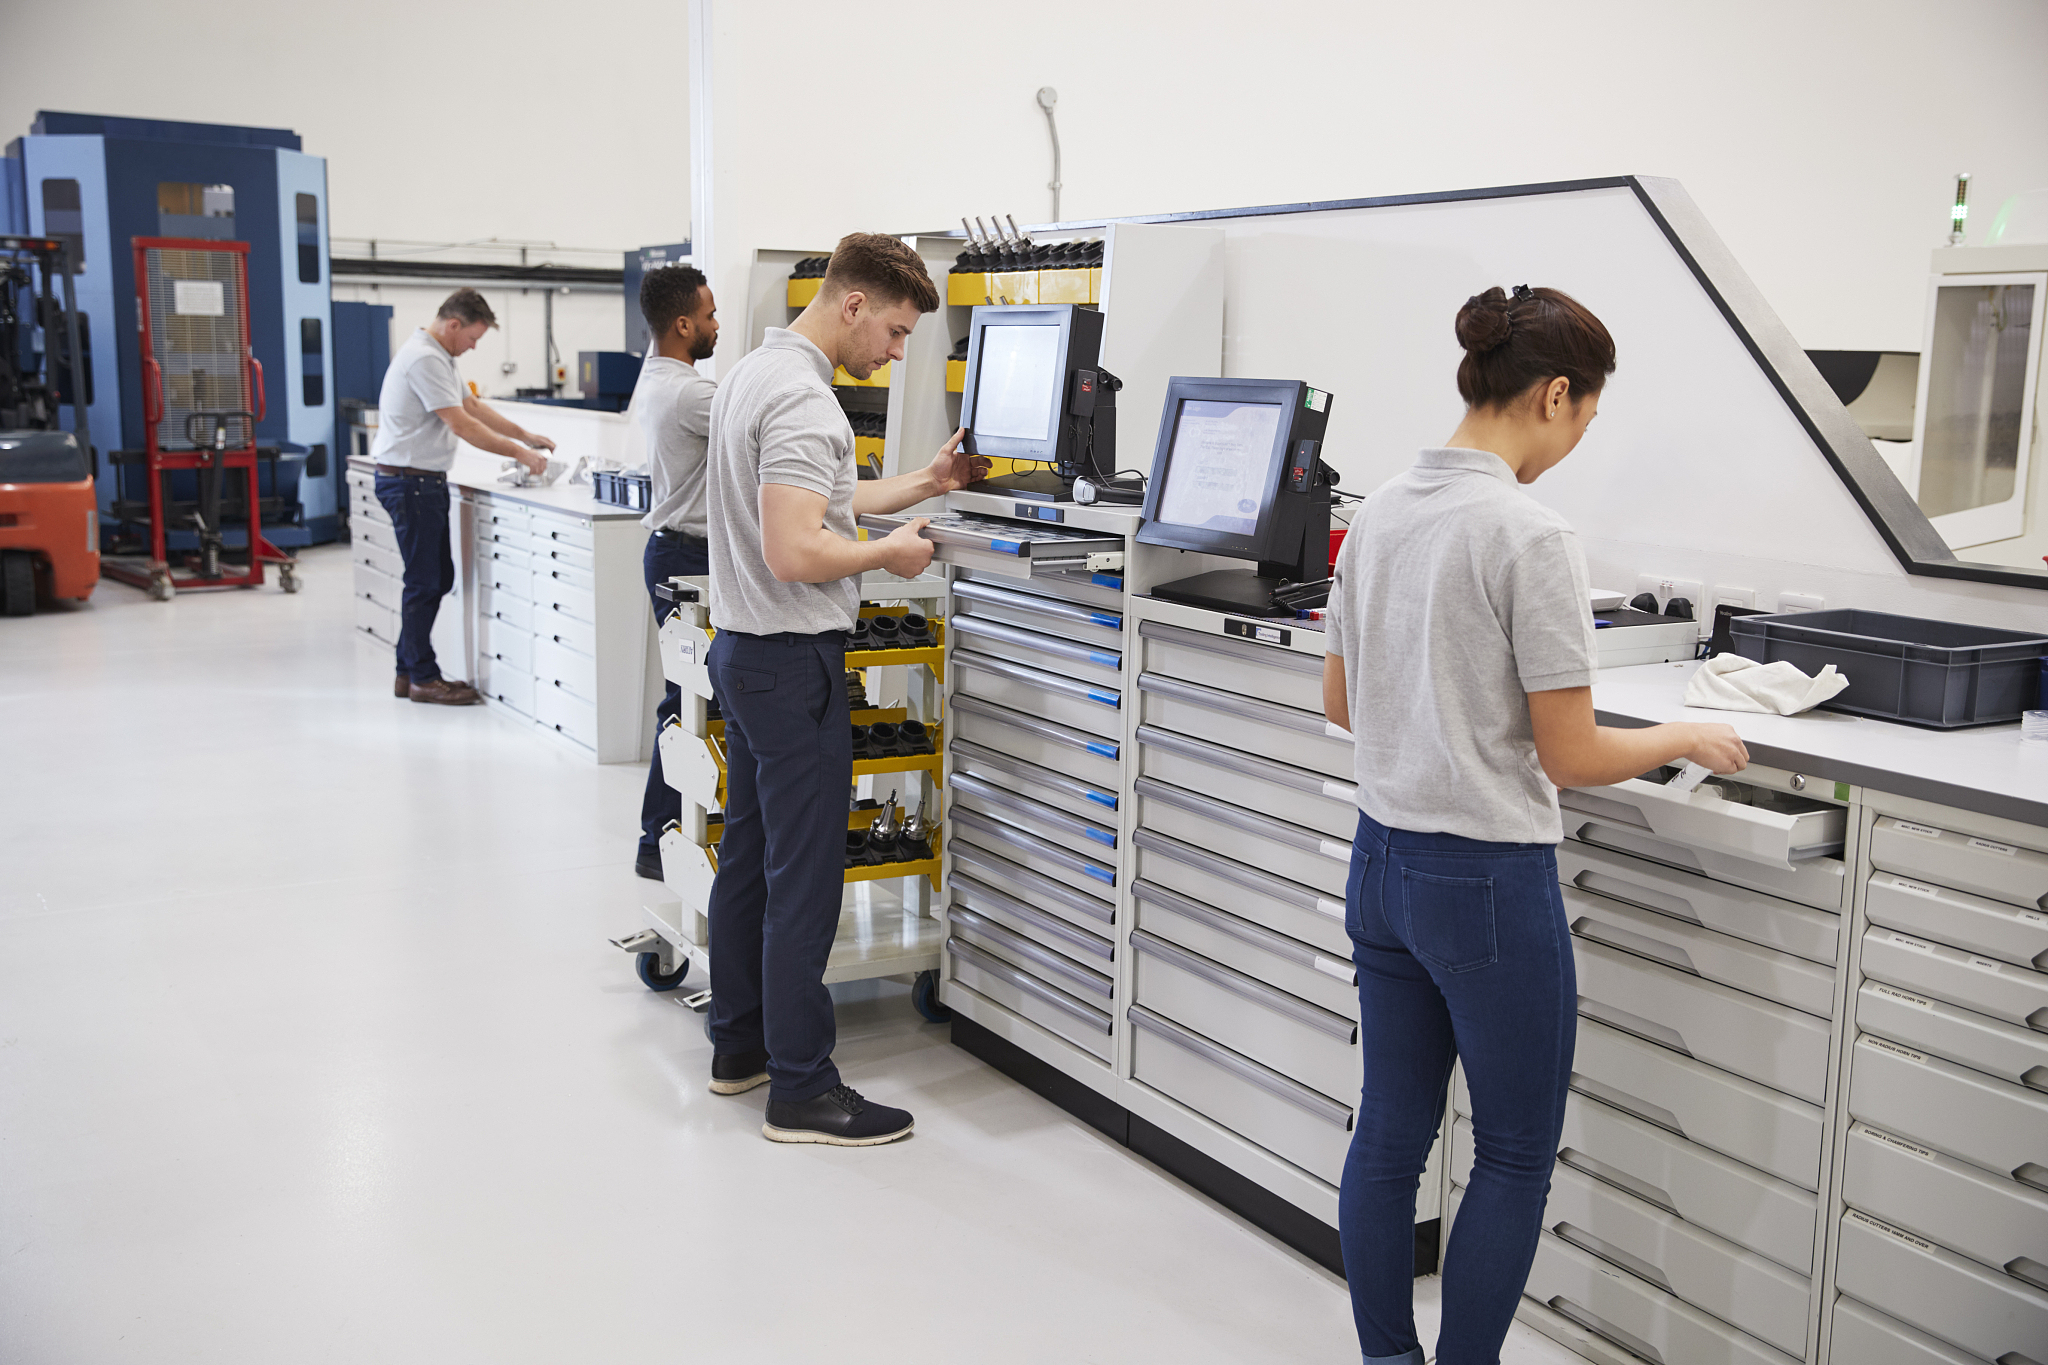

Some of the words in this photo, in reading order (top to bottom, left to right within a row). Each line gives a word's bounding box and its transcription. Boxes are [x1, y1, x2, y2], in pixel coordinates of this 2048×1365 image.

[1879, 1042, 1896, 1051] RADIUS
[1864, 1128, 1882, 1138] BORING
[1886, 1138, 1918, 1151] CHAMFERING
[1852, 1212, 1870, 1222] RADIUS
[1869, 1220, 1890, 1232] CUTTERS
[1914, 1240, 1930, 1249] OVER
